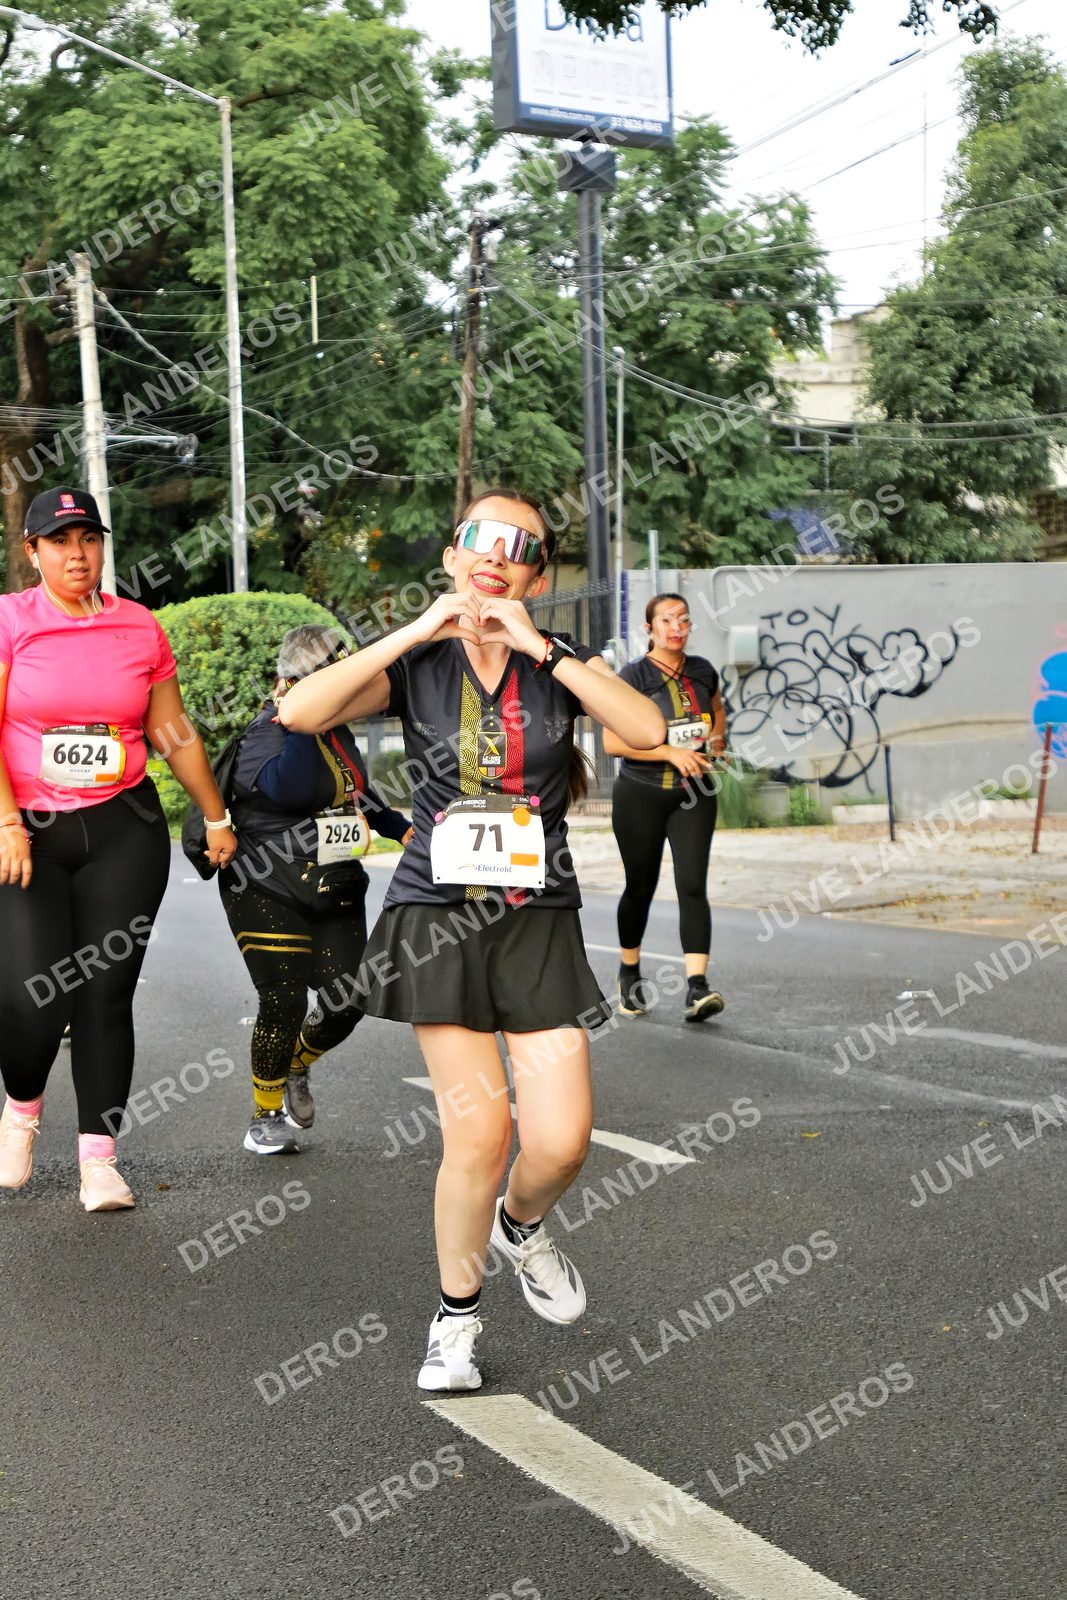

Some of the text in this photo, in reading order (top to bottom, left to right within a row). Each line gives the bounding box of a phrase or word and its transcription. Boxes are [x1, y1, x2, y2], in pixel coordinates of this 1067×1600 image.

[760, 603, 842, 635] TOY
[53, 742, 108, 766] 6624
[325, 824, 360, 844] 2926
[469, 824, 503, 852] 71
